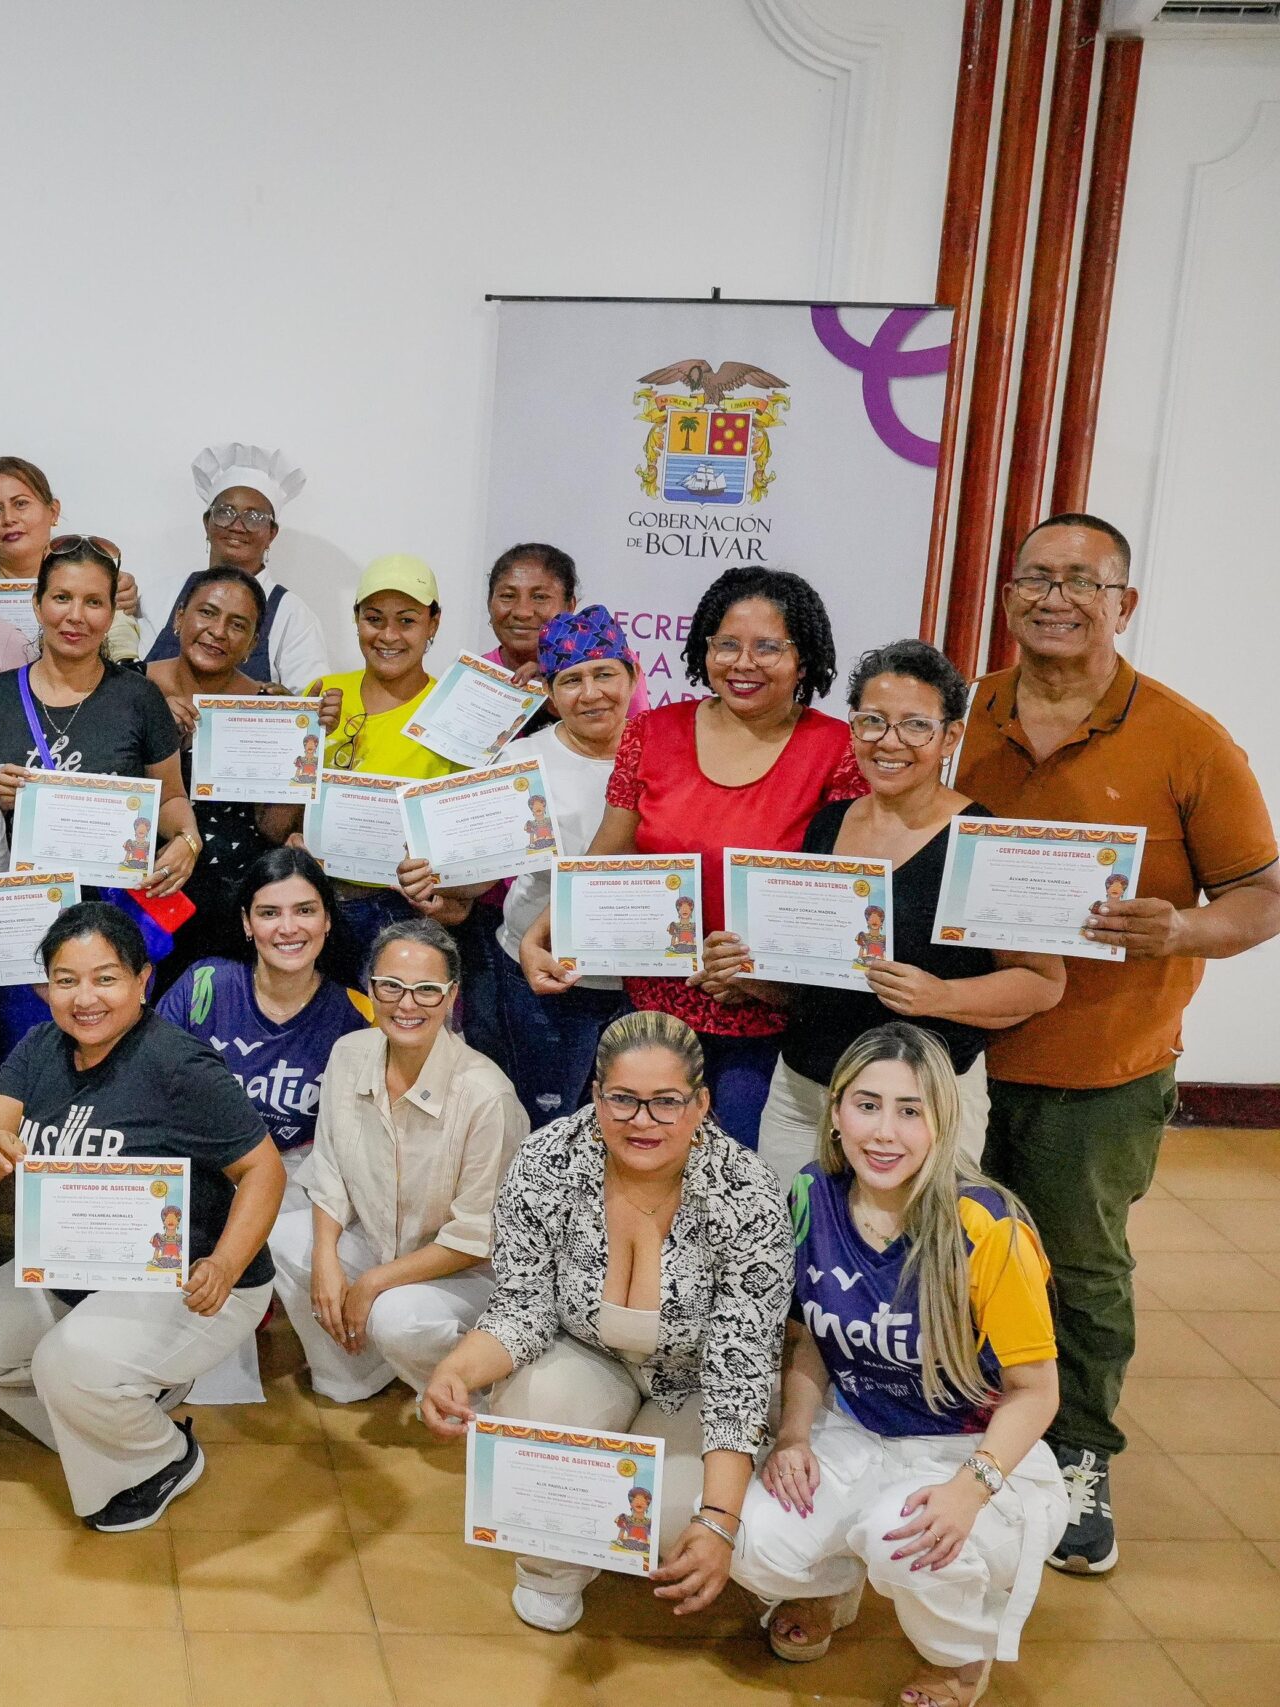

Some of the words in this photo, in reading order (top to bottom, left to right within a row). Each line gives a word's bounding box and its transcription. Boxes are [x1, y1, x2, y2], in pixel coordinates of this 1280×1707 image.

[628, 511, 772, 533] GOBERNACIÓN
[626, 537, 643, 548] DE
[645, 532, 768, 561] BOLÍVAR
[54, 793, 85, 801] CERTIFICADO
[439, 793, 471, 805] CERTIFICADO
[999, 847, 1040, 856] CERTIFICADO
[1052, 850, 1091, 859] ASISTENCIA
[768, 878, 803, 887] CERTIFICADO
[814, 882, 848, 890] ASISTENCIA
[518, 1450, 560, 1461] CERTIFICADO
[572, 1457, 611, 1469] ASISTENCIA
